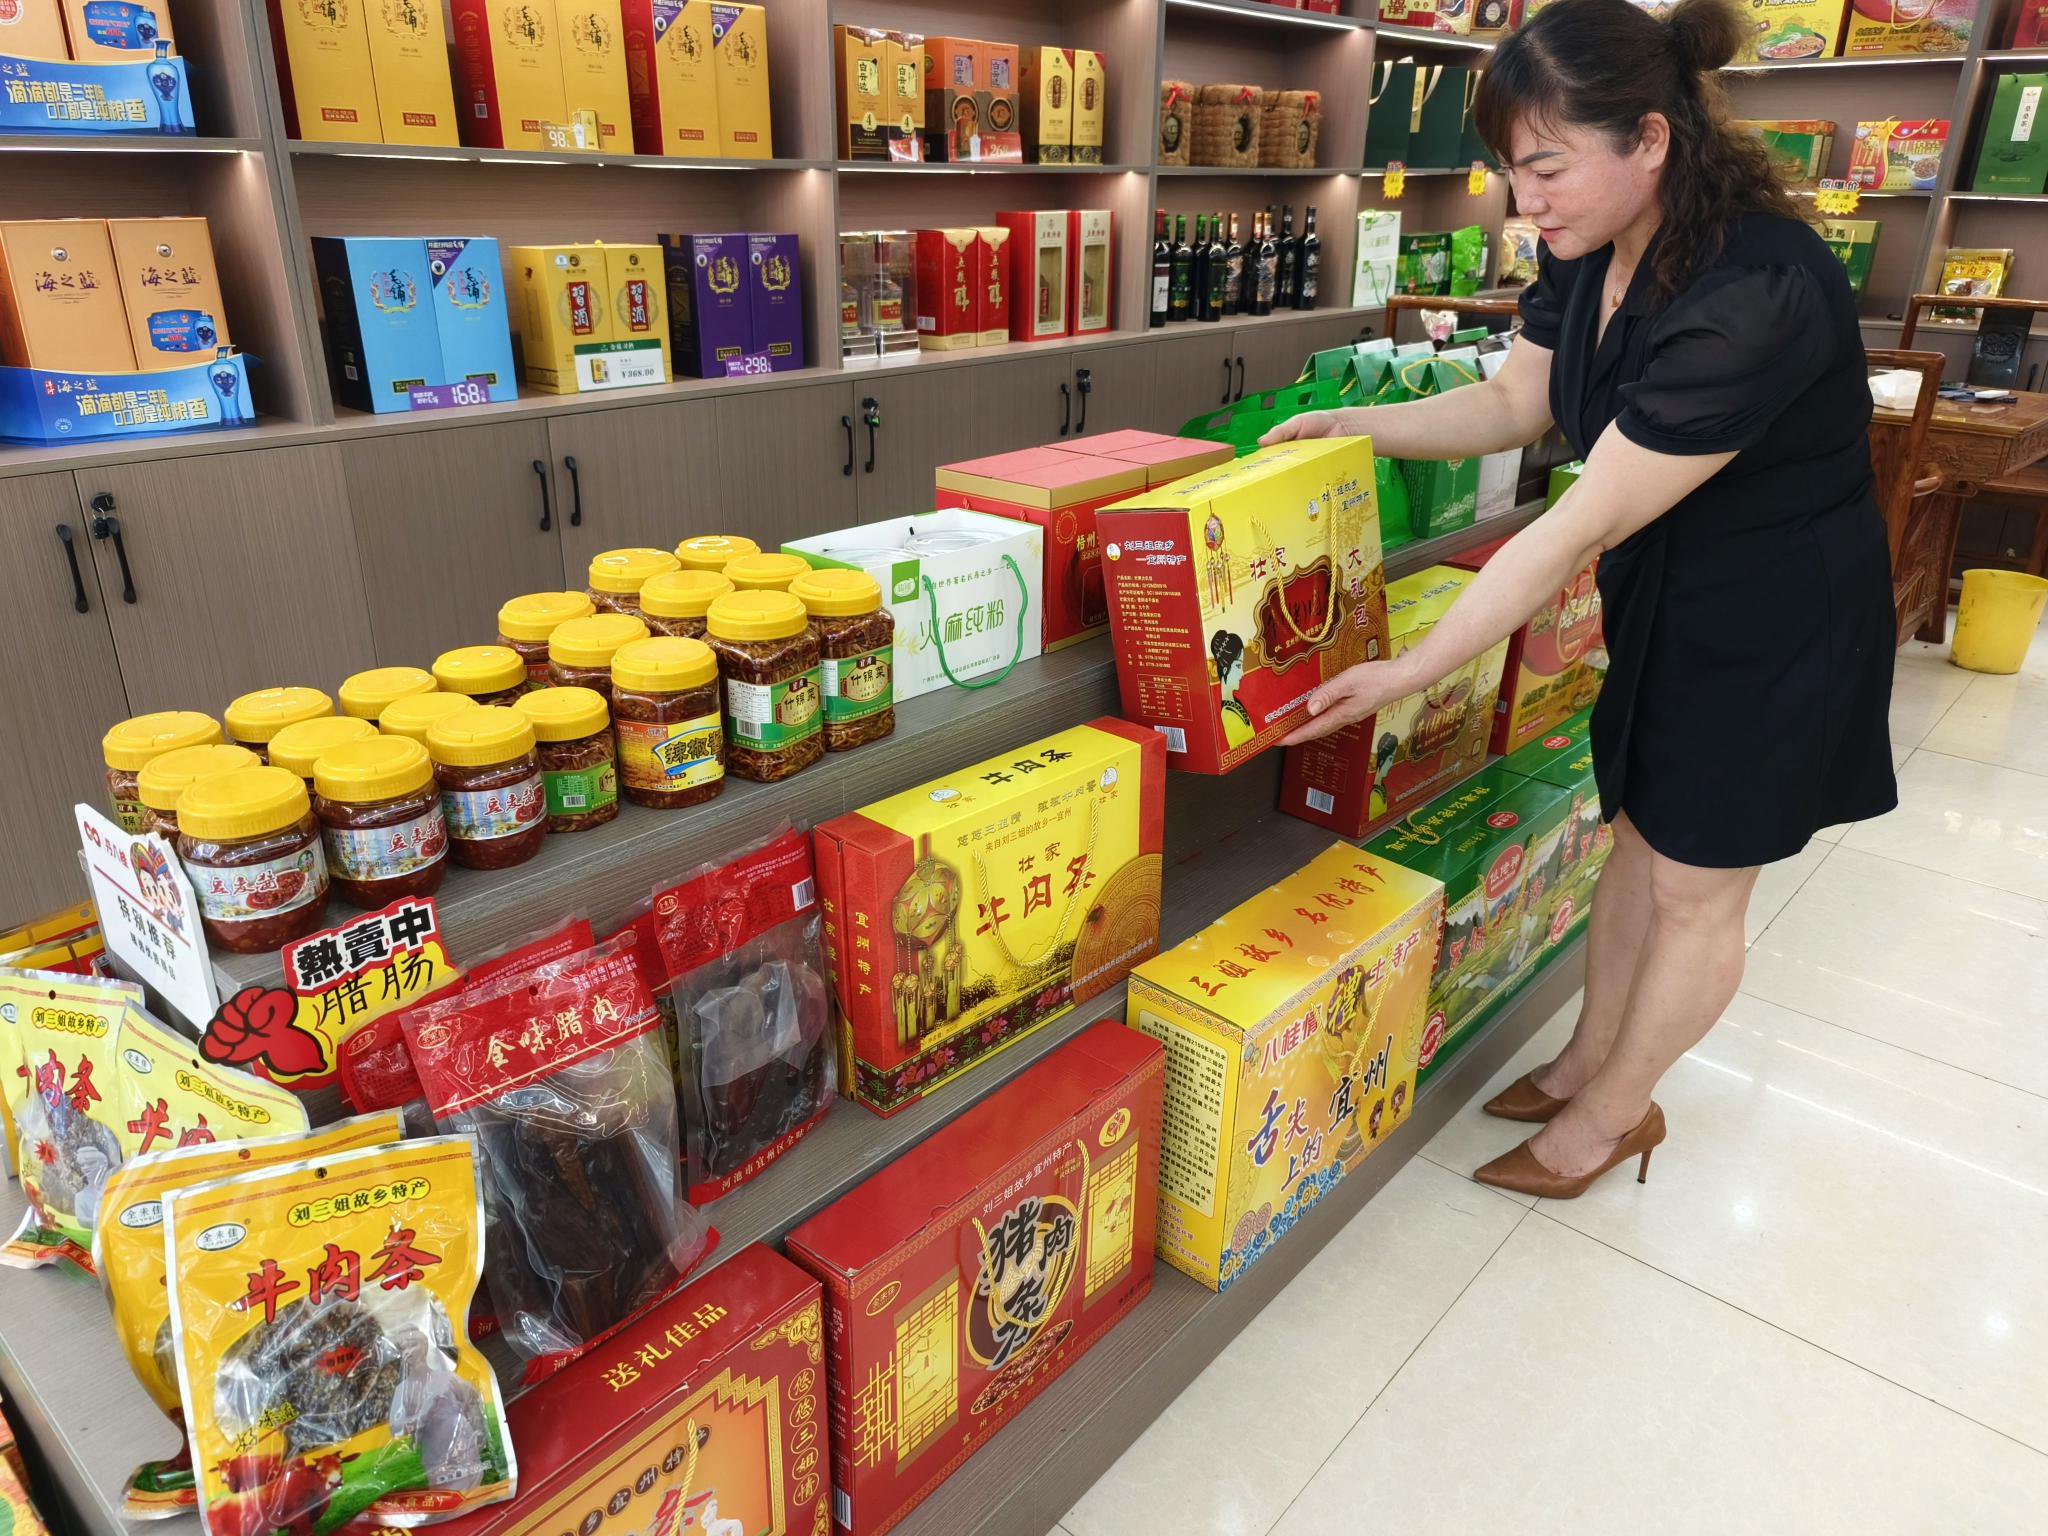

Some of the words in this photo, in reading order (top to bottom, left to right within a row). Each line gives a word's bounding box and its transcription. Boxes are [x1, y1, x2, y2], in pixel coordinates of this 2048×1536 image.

[572, 283, 589, 327] 习酒
[631, 283, 646, 324] 习酒
[745, 356, 768, 375] 298
[451, 383, 479, 405] 168
[1250, 547, 1287, 582] 壮家
[1347, 548, 1369, 629] 大礼包
[919, 598, 1005, 651] 火麻纯粉
[979, 749, 1073, 786] 牛肉条
[1018, 841, 1061, 874] 壮家
[976, 853, 1097, 937] 牛肉条
[296, 906, 432, 987] 熱賣中
[855, 911, 872, 995] 宜州特产
[319, 952, 434, 1027] 腊肠
[34, 1008, 108, 1038] 刘三姐故乡特产
[485, 994, 620, 1069] 全味腊肉
[179, 1073, 266, 1119] 刘三姐故乡特产
[127, 1098, 243, 1155] 牛肉
[293, 1180, 428, 1223] 刘三姐故乡特产
[982, 1141, 1073, 1218] 刘三姐故乡宜州特产
[227, 1226, 442, 1325] 牛肉条
[601, 1303, 729, 1393] 送礼佳品
[793, 1371, 816, 1503] 悠悠三姐情
